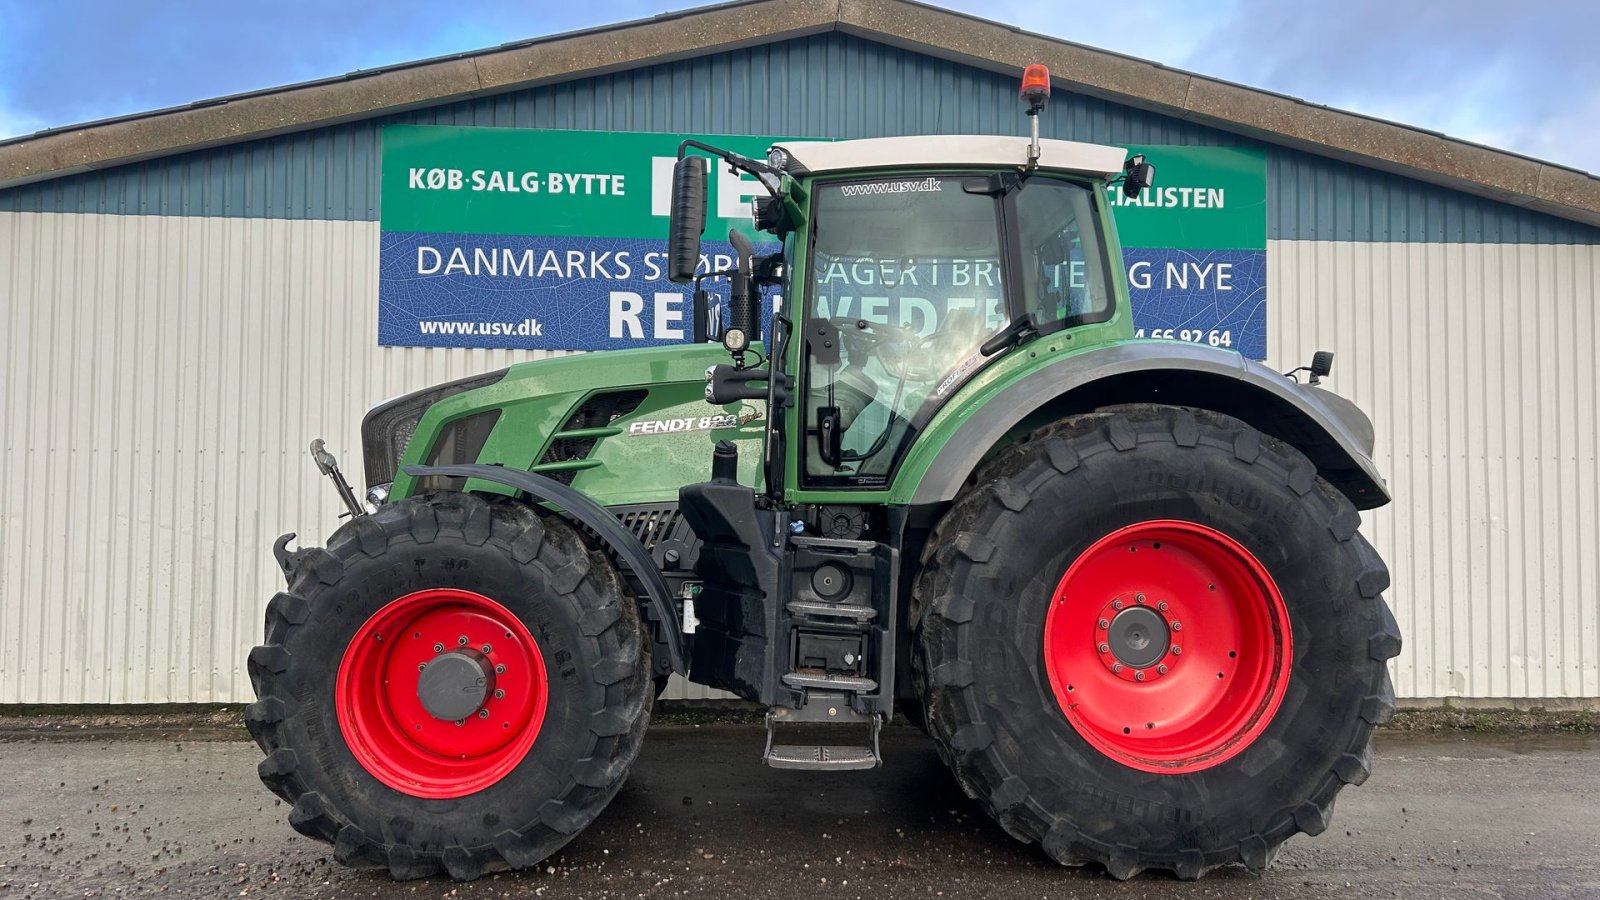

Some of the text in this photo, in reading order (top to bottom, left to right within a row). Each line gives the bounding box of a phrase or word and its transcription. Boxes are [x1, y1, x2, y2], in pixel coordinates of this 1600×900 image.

[841, 178, 942, 196] www.usv.dk
[417, 246, 631, 280] DANMARKS
[1129, 262, 1152, 289] G
[1166, 262, 1233, 290] NYE
[419, 319, 542, 336] www.usv.dk
[1208, 330, 1232, 347] 64
[629, 417, 697, 432] FENDT
